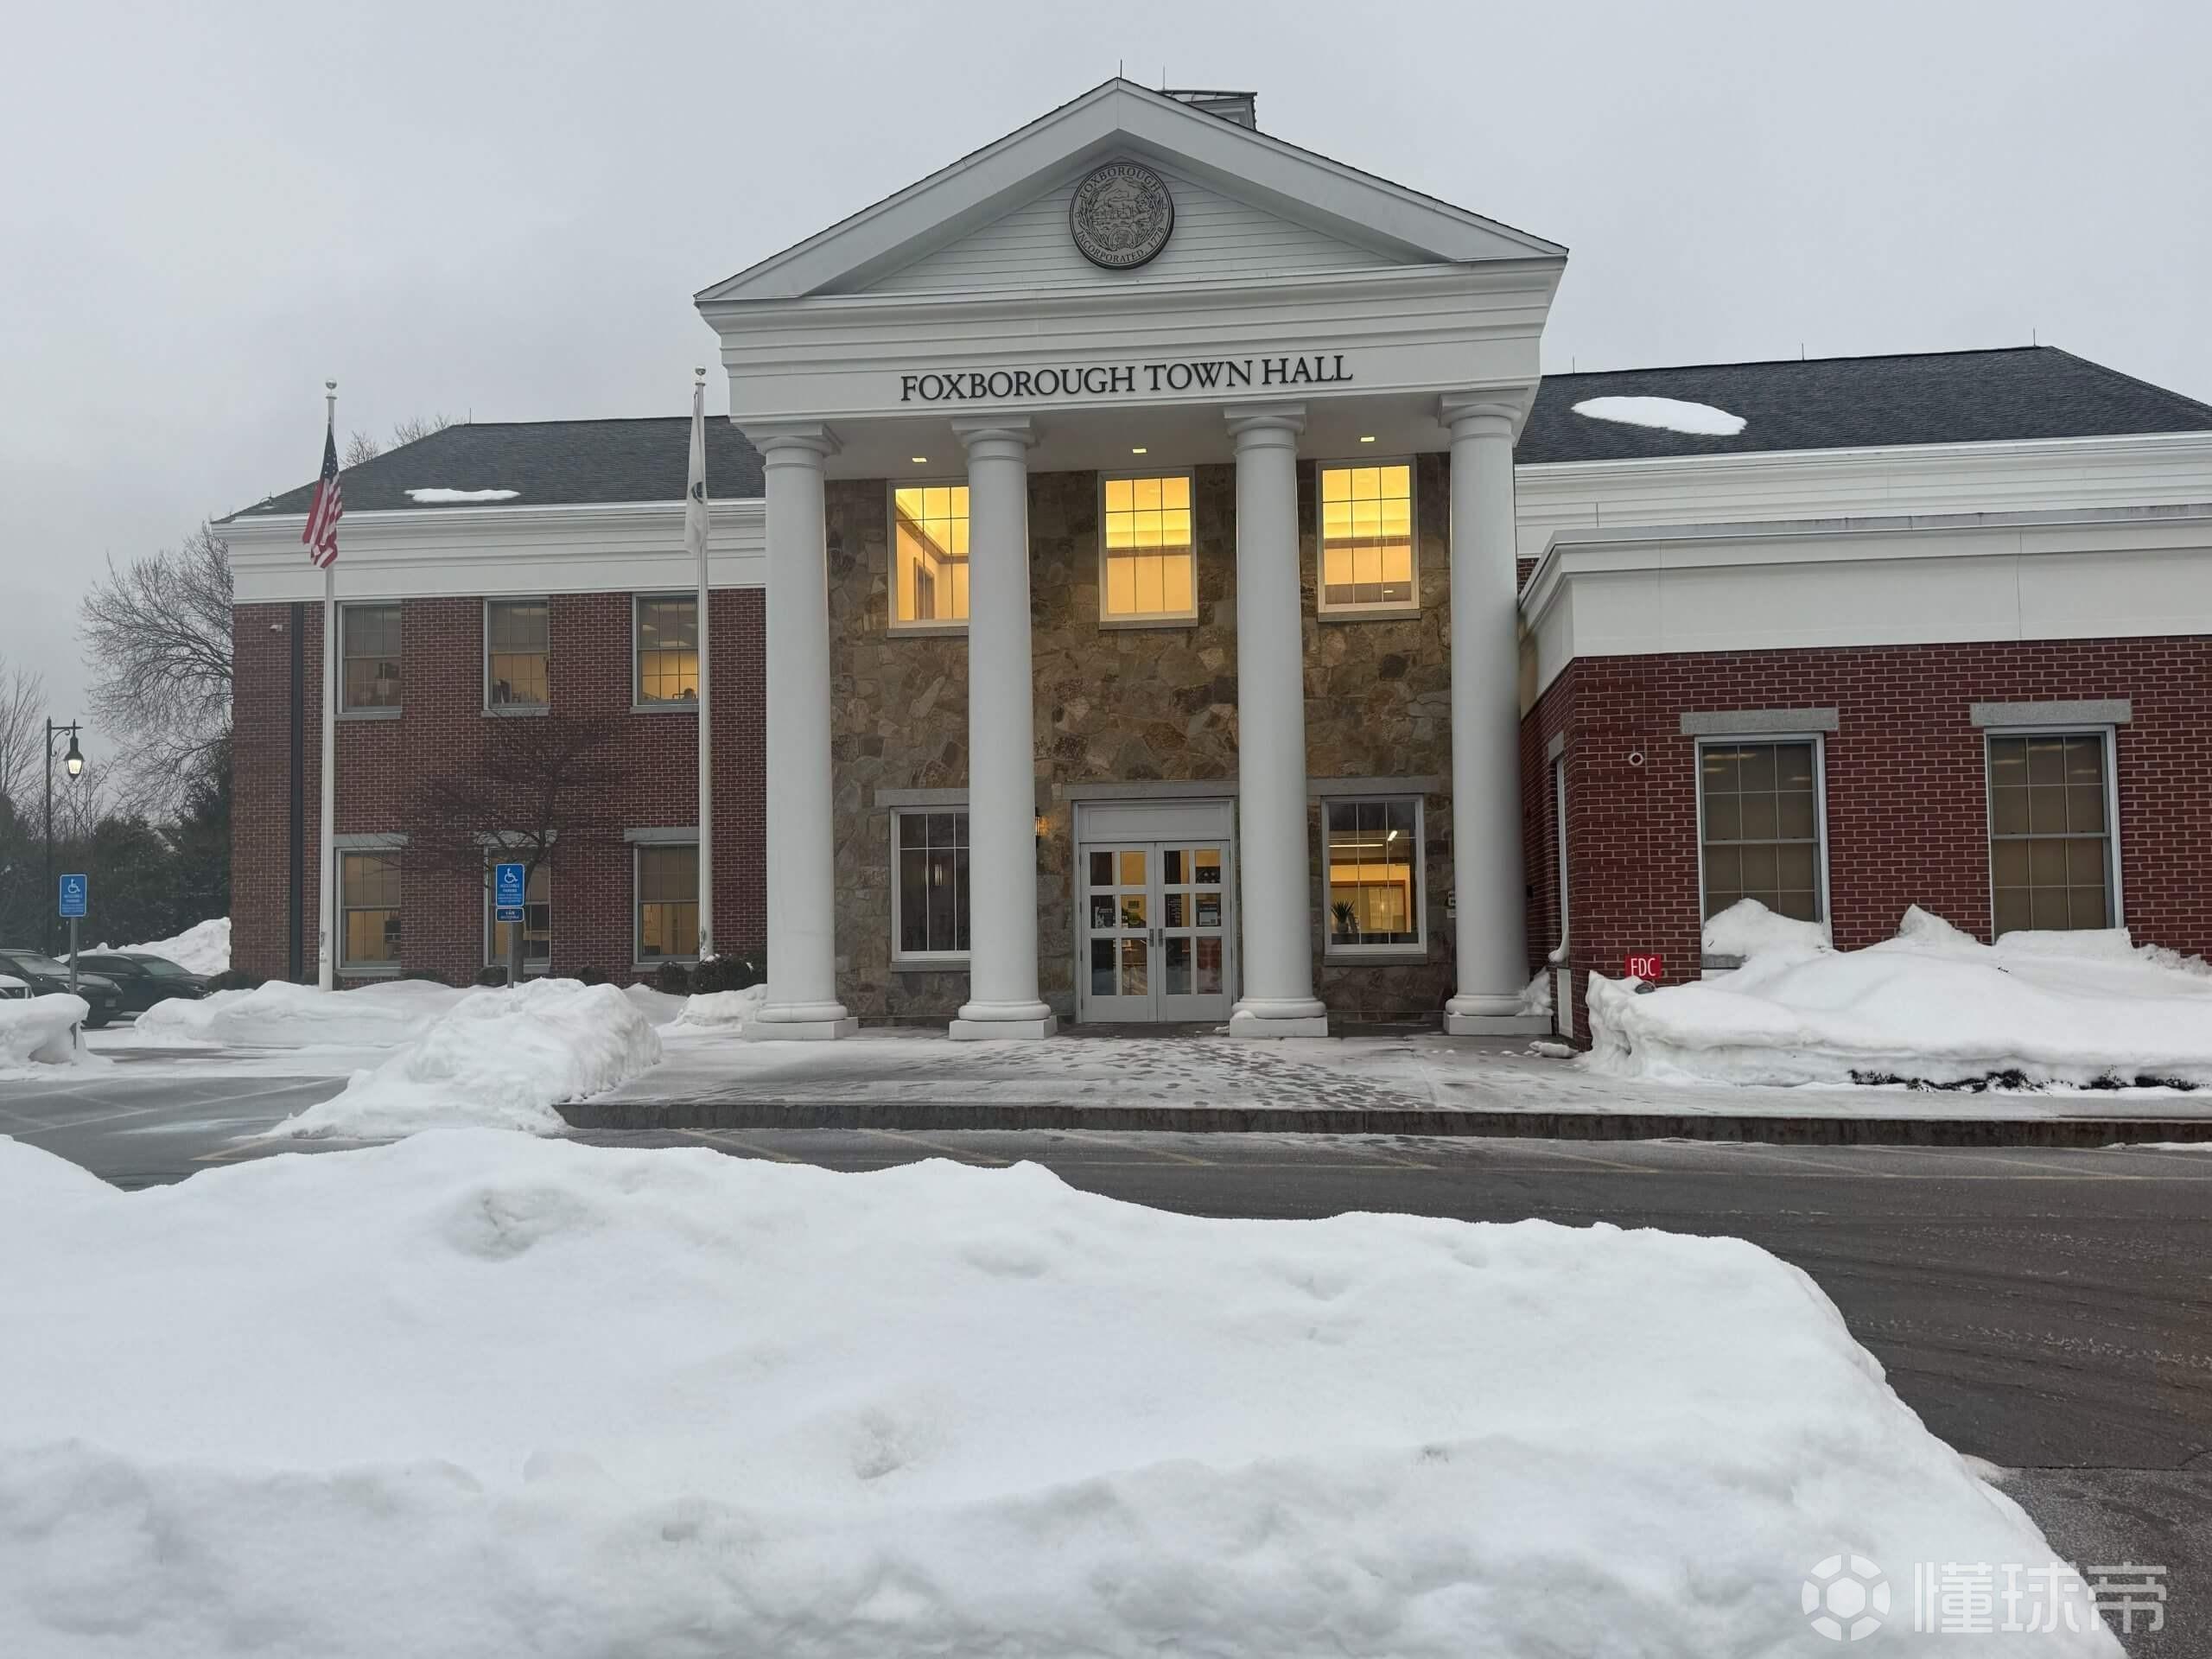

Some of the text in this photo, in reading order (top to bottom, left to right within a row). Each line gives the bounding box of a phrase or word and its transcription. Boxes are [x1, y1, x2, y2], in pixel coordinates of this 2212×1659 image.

[1079, 167, 1160, 200] FOXBOROUGH
[1148, 226, 1165, 249] 1778
[900, 355, 1353, 401] FOXBOROUGH TOWN HALL
[1630, 957, 1656, 976] FDC
